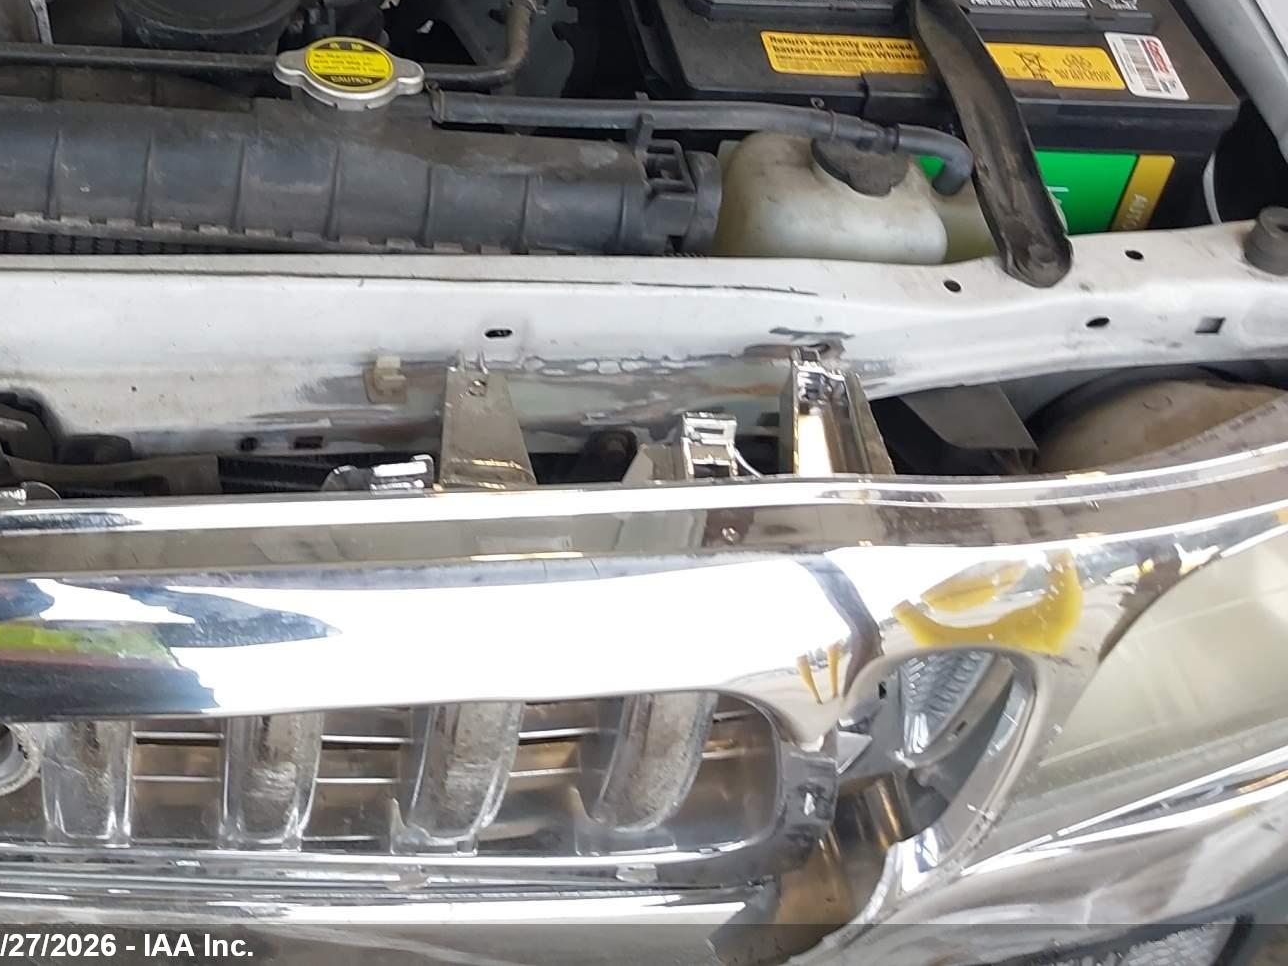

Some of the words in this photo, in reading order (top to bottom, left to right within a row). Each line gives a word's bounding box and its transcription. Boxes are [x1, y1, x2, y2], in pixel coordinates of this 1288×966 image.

[768, 35, 807, 45] Return
[809, 40, 859, 50] warranty
[862, 41, 883, 49] and
[885, 42, 913, 51] used
[773, 45, 821, 55] batteries
